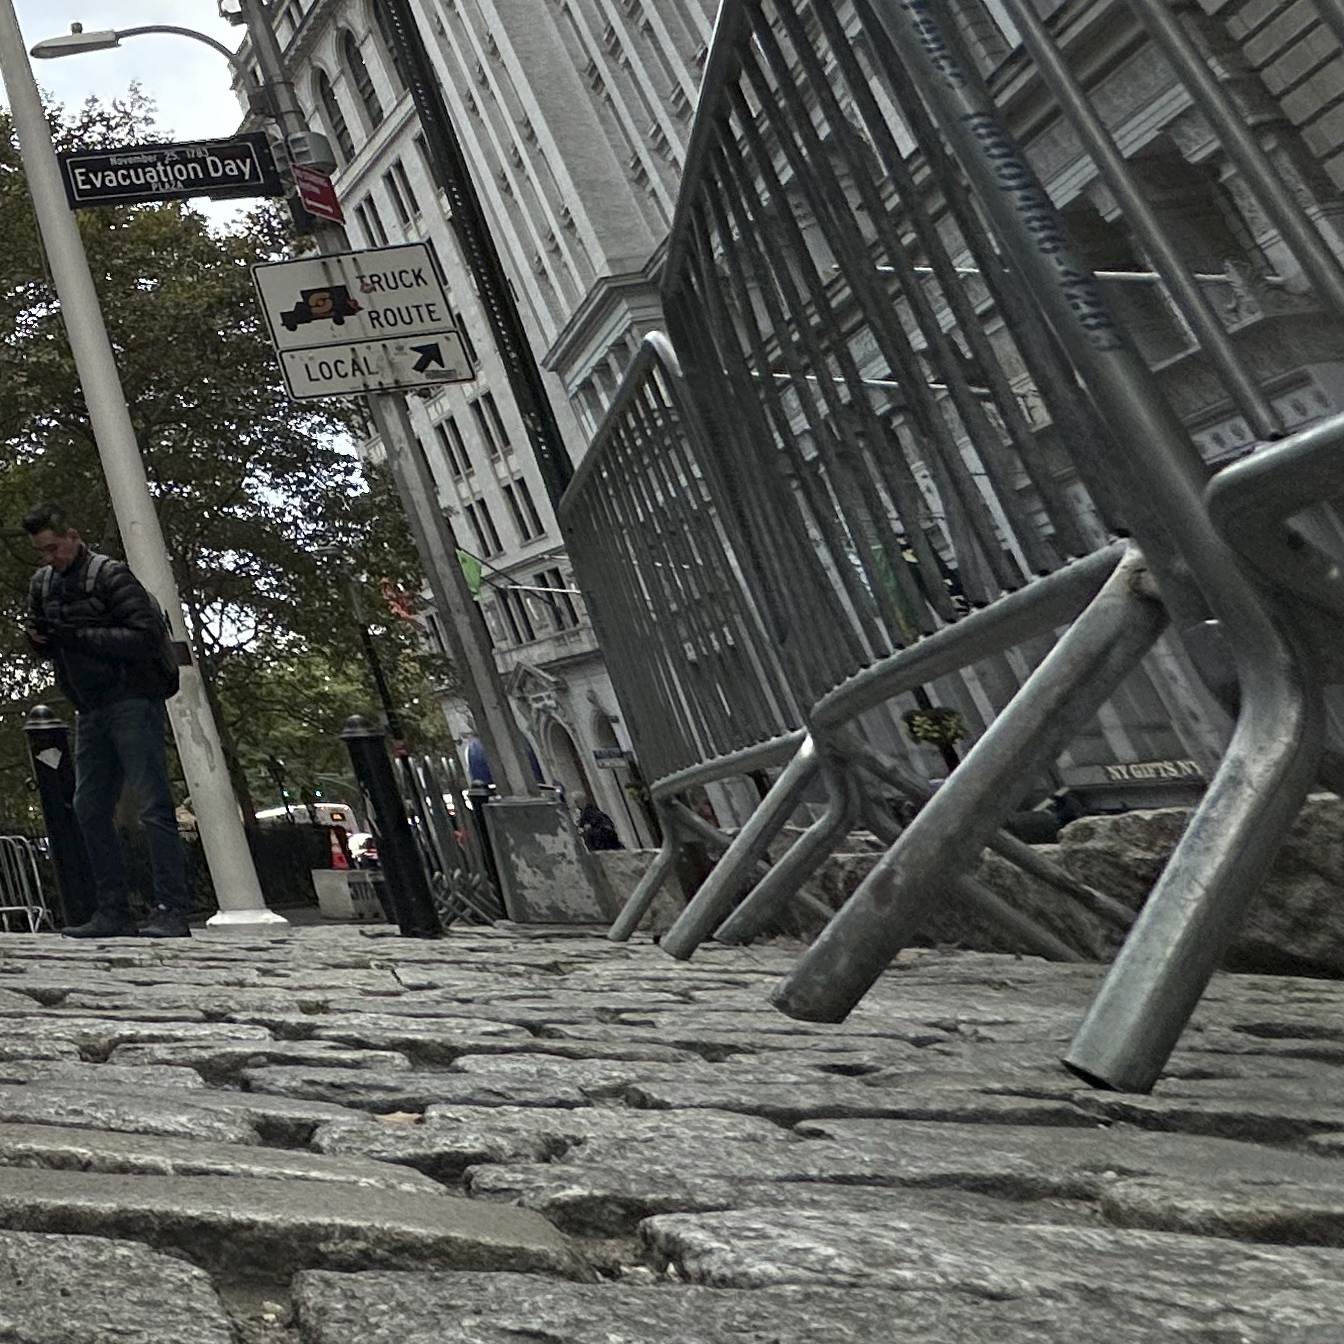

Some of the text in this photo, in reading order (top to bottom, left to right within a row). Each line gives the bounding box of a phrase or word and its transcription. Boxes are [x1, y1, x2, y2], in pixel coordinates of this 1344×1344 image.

[74, 155, 252, 190] Evacuation Day
[109, 153, 158, 167] November
[151, 181, 184, 192] PLAZA
[356, 268, 429, 293] TRUCK
[368, 302, 442, 329] ROUTE
[305, 356, 379, 382] LOCAL
[1129, 760, 1180, 778] GIFTS
